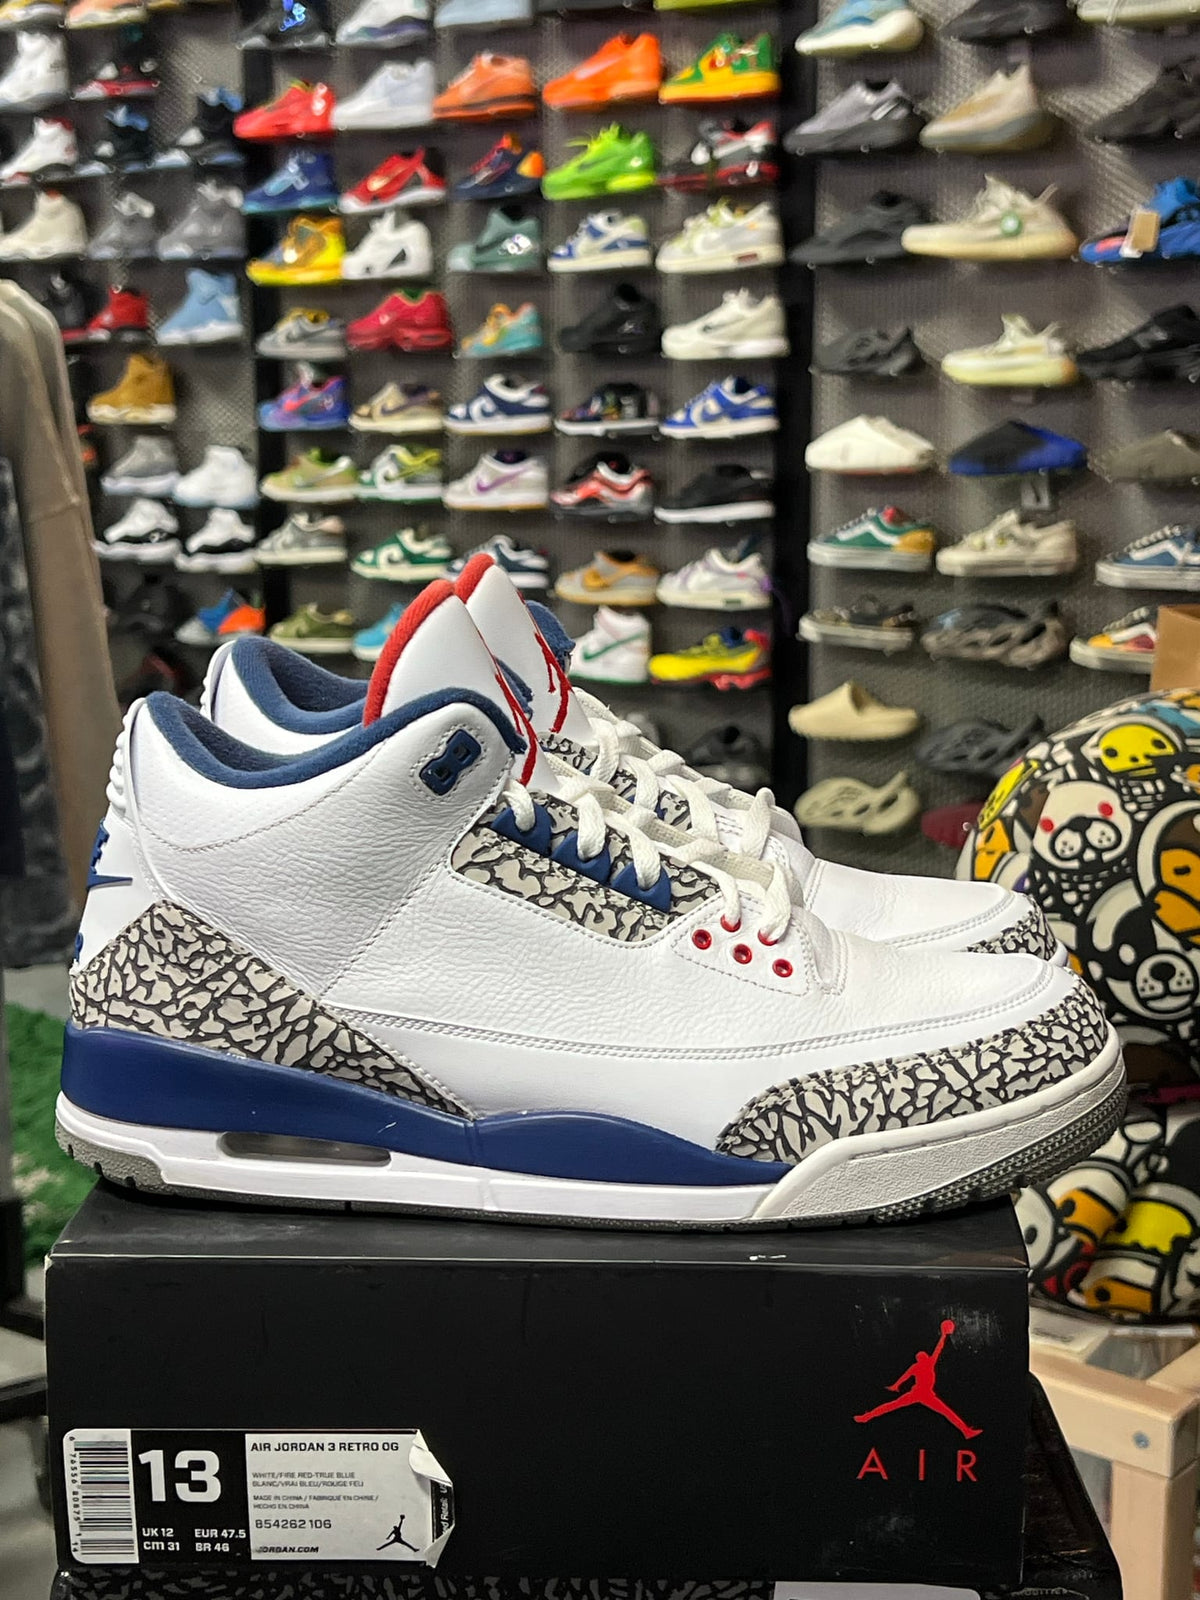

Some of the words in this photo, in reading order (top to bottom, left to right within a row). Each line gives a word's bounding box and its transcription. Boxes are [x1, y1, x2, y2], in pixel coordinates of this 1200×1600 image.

[250, 1442, 272, 1452] AIR
[274, 1442, 325, 1452] JORDAN
[328, 1442, 336, 1452] 3
[339, 1442, 379, 1452] RETRO
[382, 1442, 399, 1451] OG
[856, 1447, 978, 1482] AIR
[138, 1449, 222, 1503] 13
[252, 1472, 296, 1480] WHITE/FIRE
[252, 1480, 298, 1488] BLANC/VRAI
[299, 1480, 347, 1488] BLEU/ROUGE
[142, 1527, 159, 1537] UK
[161, 1528, 174, 1537] 12
[194, 1528, 218, 1538] EUR
[221, 1529, 246, 1539] 47.5
[167, 1541, 180, 1551] 31
[195, 1542, 212, 1552] BR
[214, 1542, 230, 1552] 46
